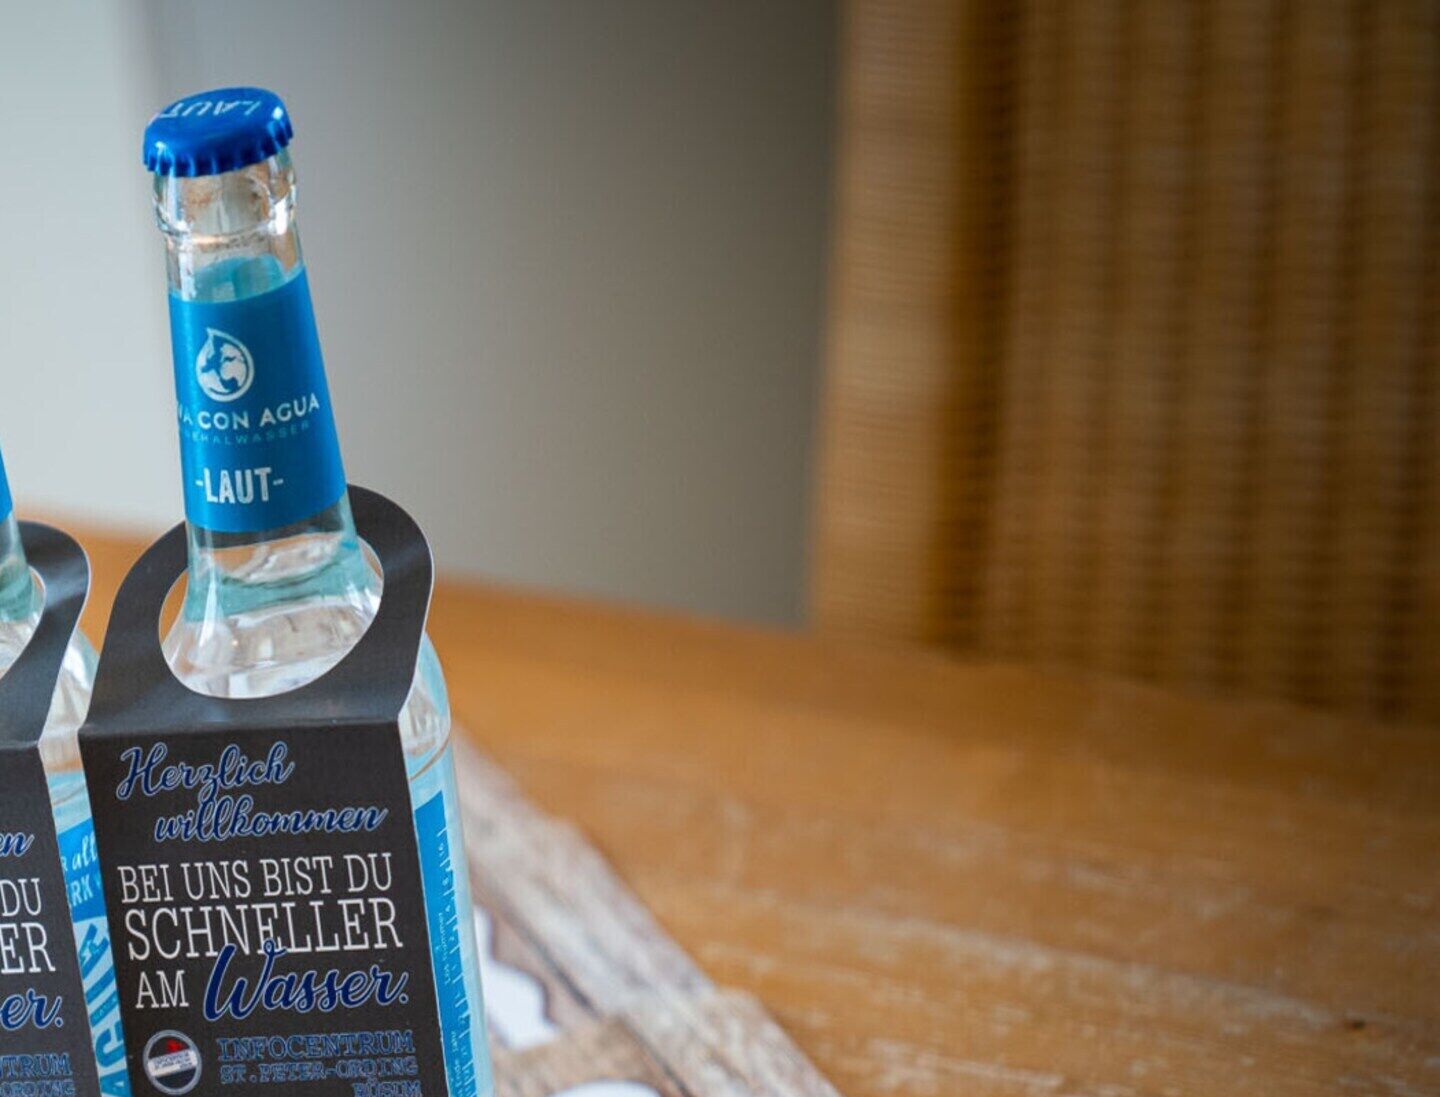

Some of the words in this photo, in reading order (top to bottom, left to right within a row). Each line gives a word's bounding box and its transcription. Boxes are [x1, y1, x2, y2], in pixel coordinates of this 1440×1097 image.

[197, 410, 250, 430] CON
[260, 392, 320, 427] AGUA
[116, 741, 295, 801] Herzlich
[154, 794, 389, 842] willkommen
[117, 864, 174, 903] BEI
[181, 860, 252, 900] UNS
[260, 856, 334, 897] BIST
[343, 853, 392, 892] DU
[124, 898, 403, 960] SCHNELLER
[135, 970, 189, 1009] AM
[216, 1030, 416, 1061] INFOCENTRUM
